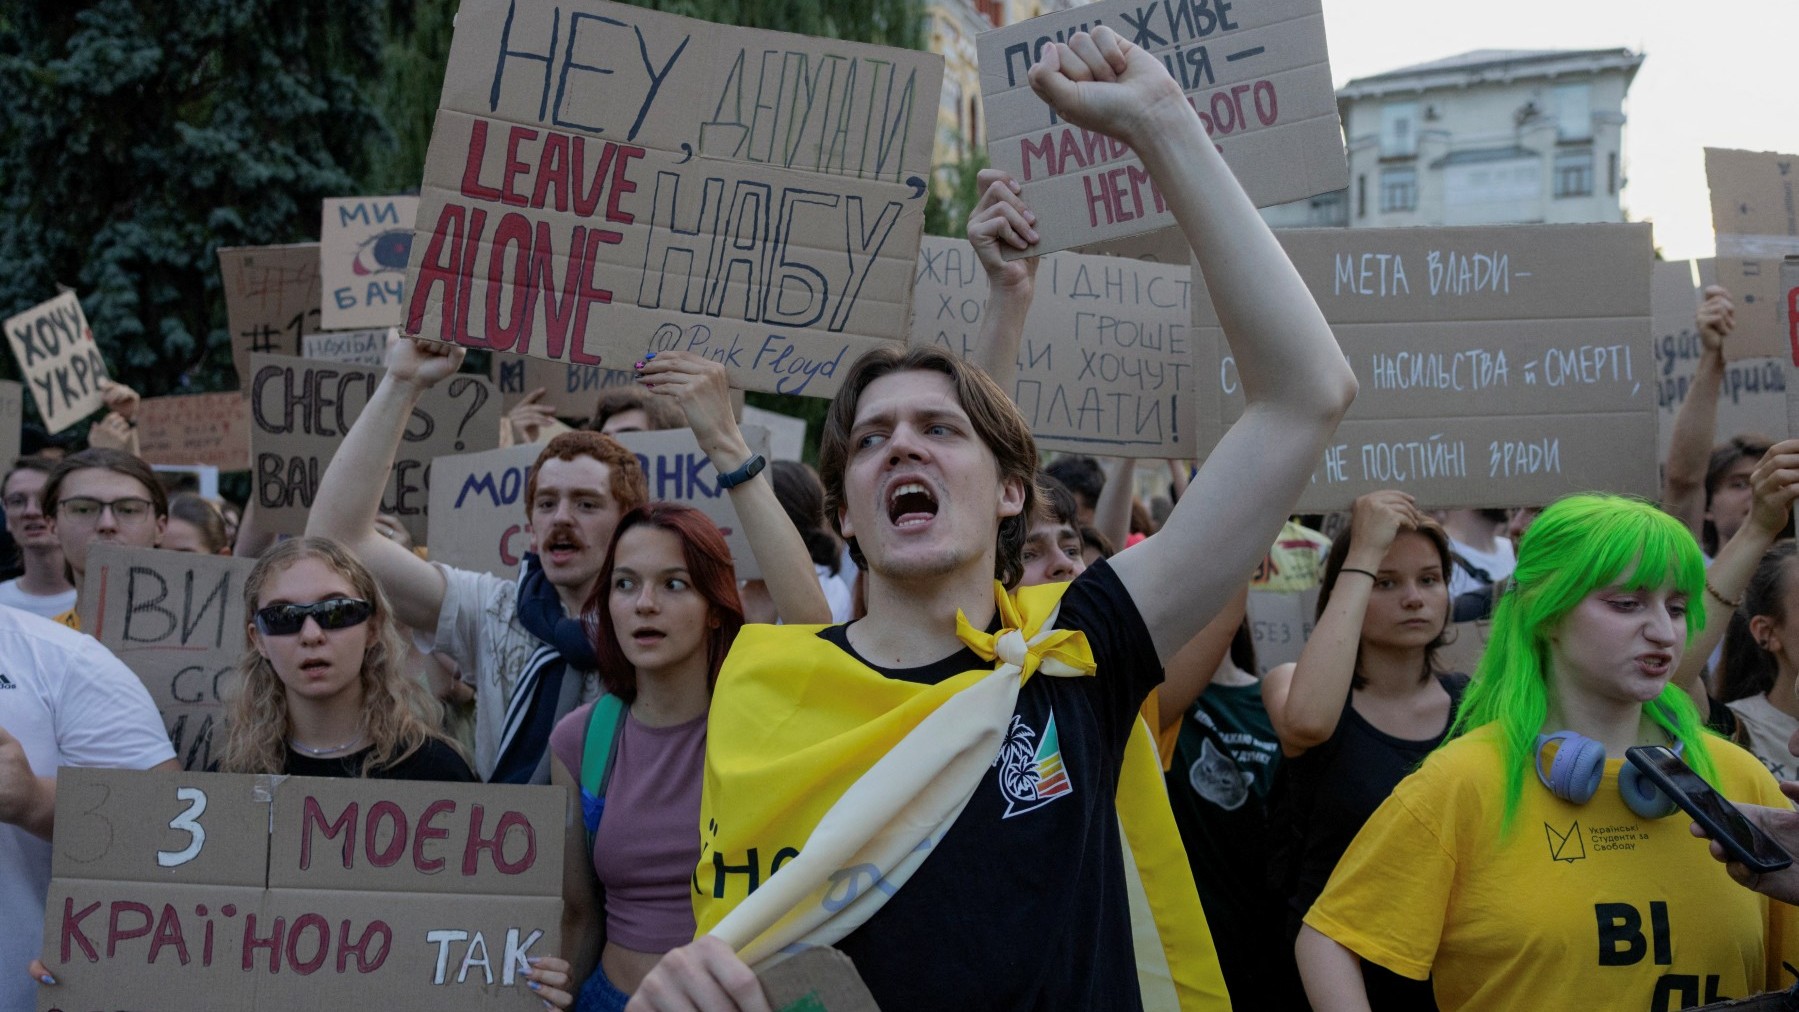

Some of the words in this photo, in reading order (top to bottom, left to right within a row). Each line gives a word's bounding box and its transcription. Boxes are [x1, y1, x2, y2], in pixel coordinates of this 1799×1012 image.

[1119, 0, 1239, 50] ЖИВЕ
[460, 118, 646, 225] LEAVE
[338, 202, 400, 228] МИ
[636, 170, 903, 333] НАБУ
[1334, 252, 1410, 297] МЕТА
[403, 203, 624, 366] ALONE
[13, 300, 82, 367] ХОЧУ
[752, 333, 850, 395] Floyd
[1372, 347, 1509, 392] НАСИЛЬСТВА
[1324, 443, 1350, 482] НЕ
[1361, 433, 1467, 482] ПОСТІЙНІ
[1488, 437, 1561, 479] ЗРАДИ
[299, 795, 538, 877] МОЄЮ
[1588, 824, 1640, 836] Українські
[1591, 834, 1636, 844] Студенти
[1593, 842, 1636, 852] Свободу
[60, 896, 394, 976] КРАЇНОЮ
[425, 926, 545, 987] ТАК
